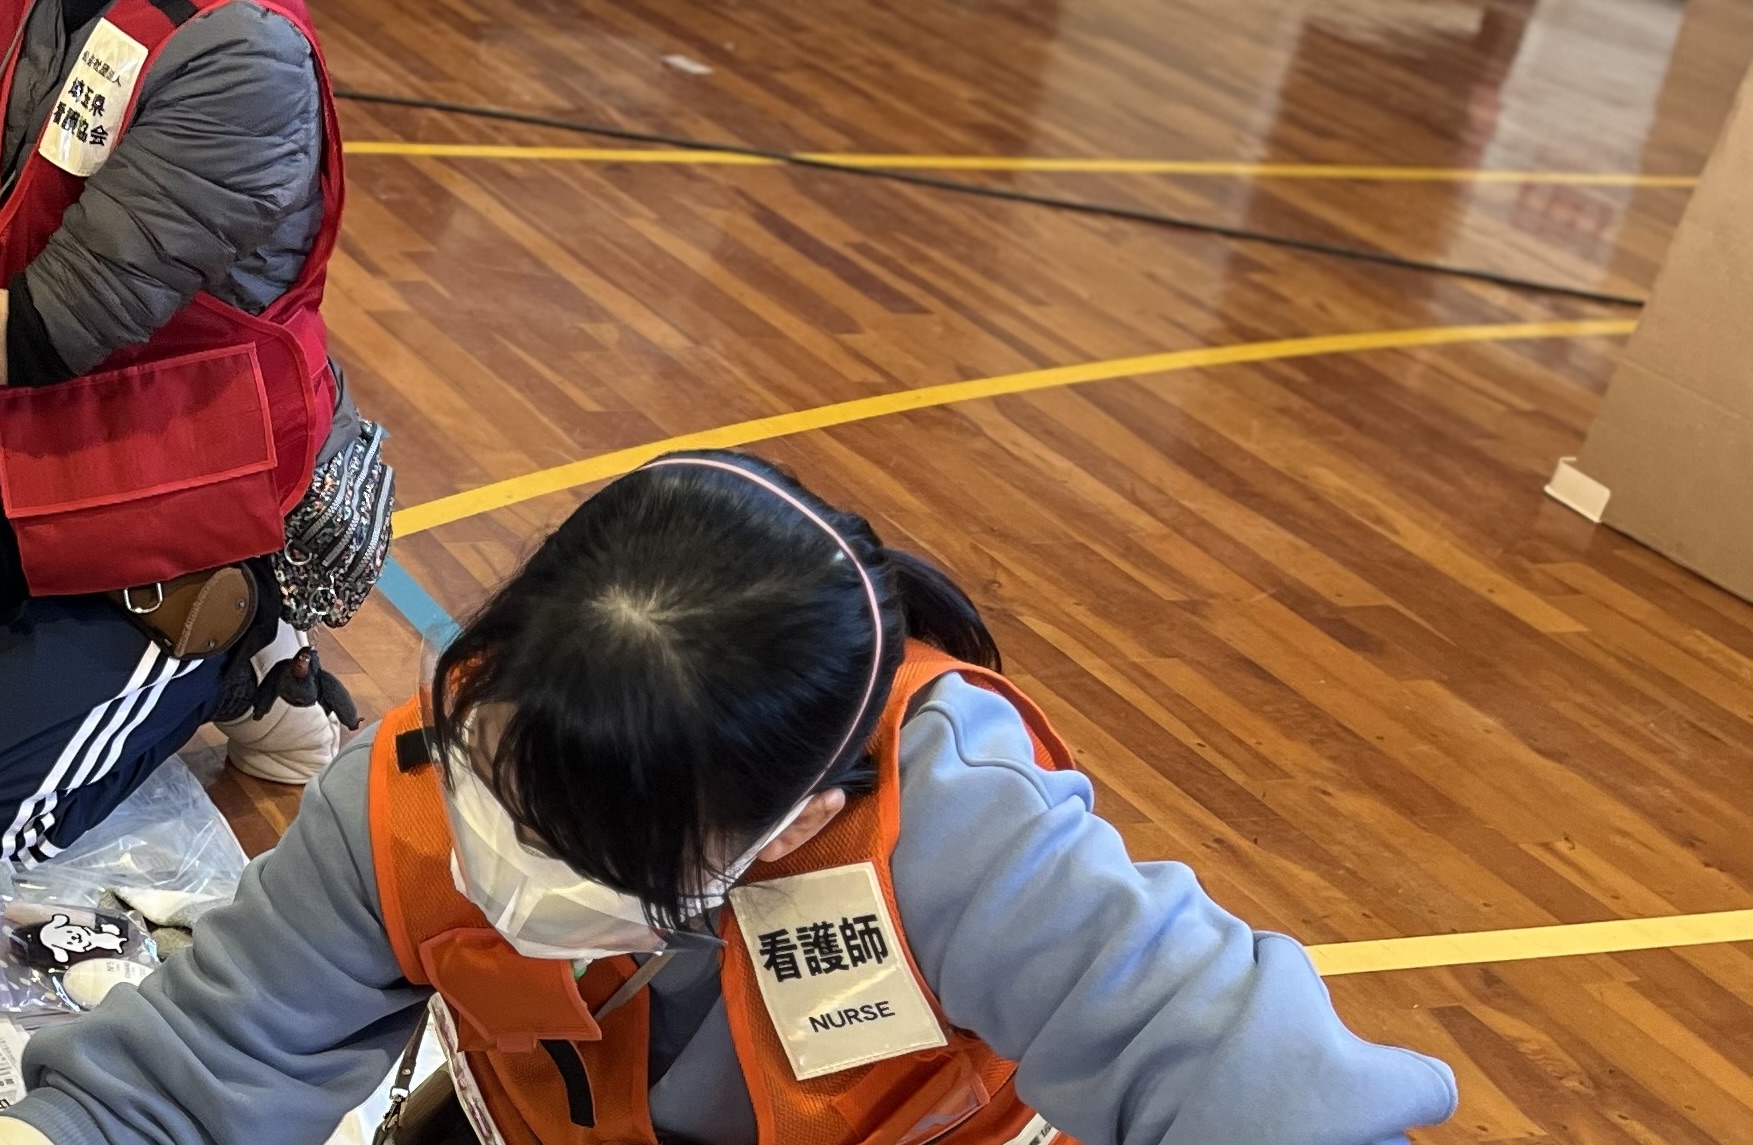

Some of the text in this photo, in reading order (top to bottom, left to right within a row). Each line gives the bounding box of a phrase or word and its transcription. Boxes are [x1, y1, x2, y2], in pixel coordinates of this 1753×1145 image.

[758, 913, 890, 983] 看護師
[808, 1000, 896, 1033] NURSE
